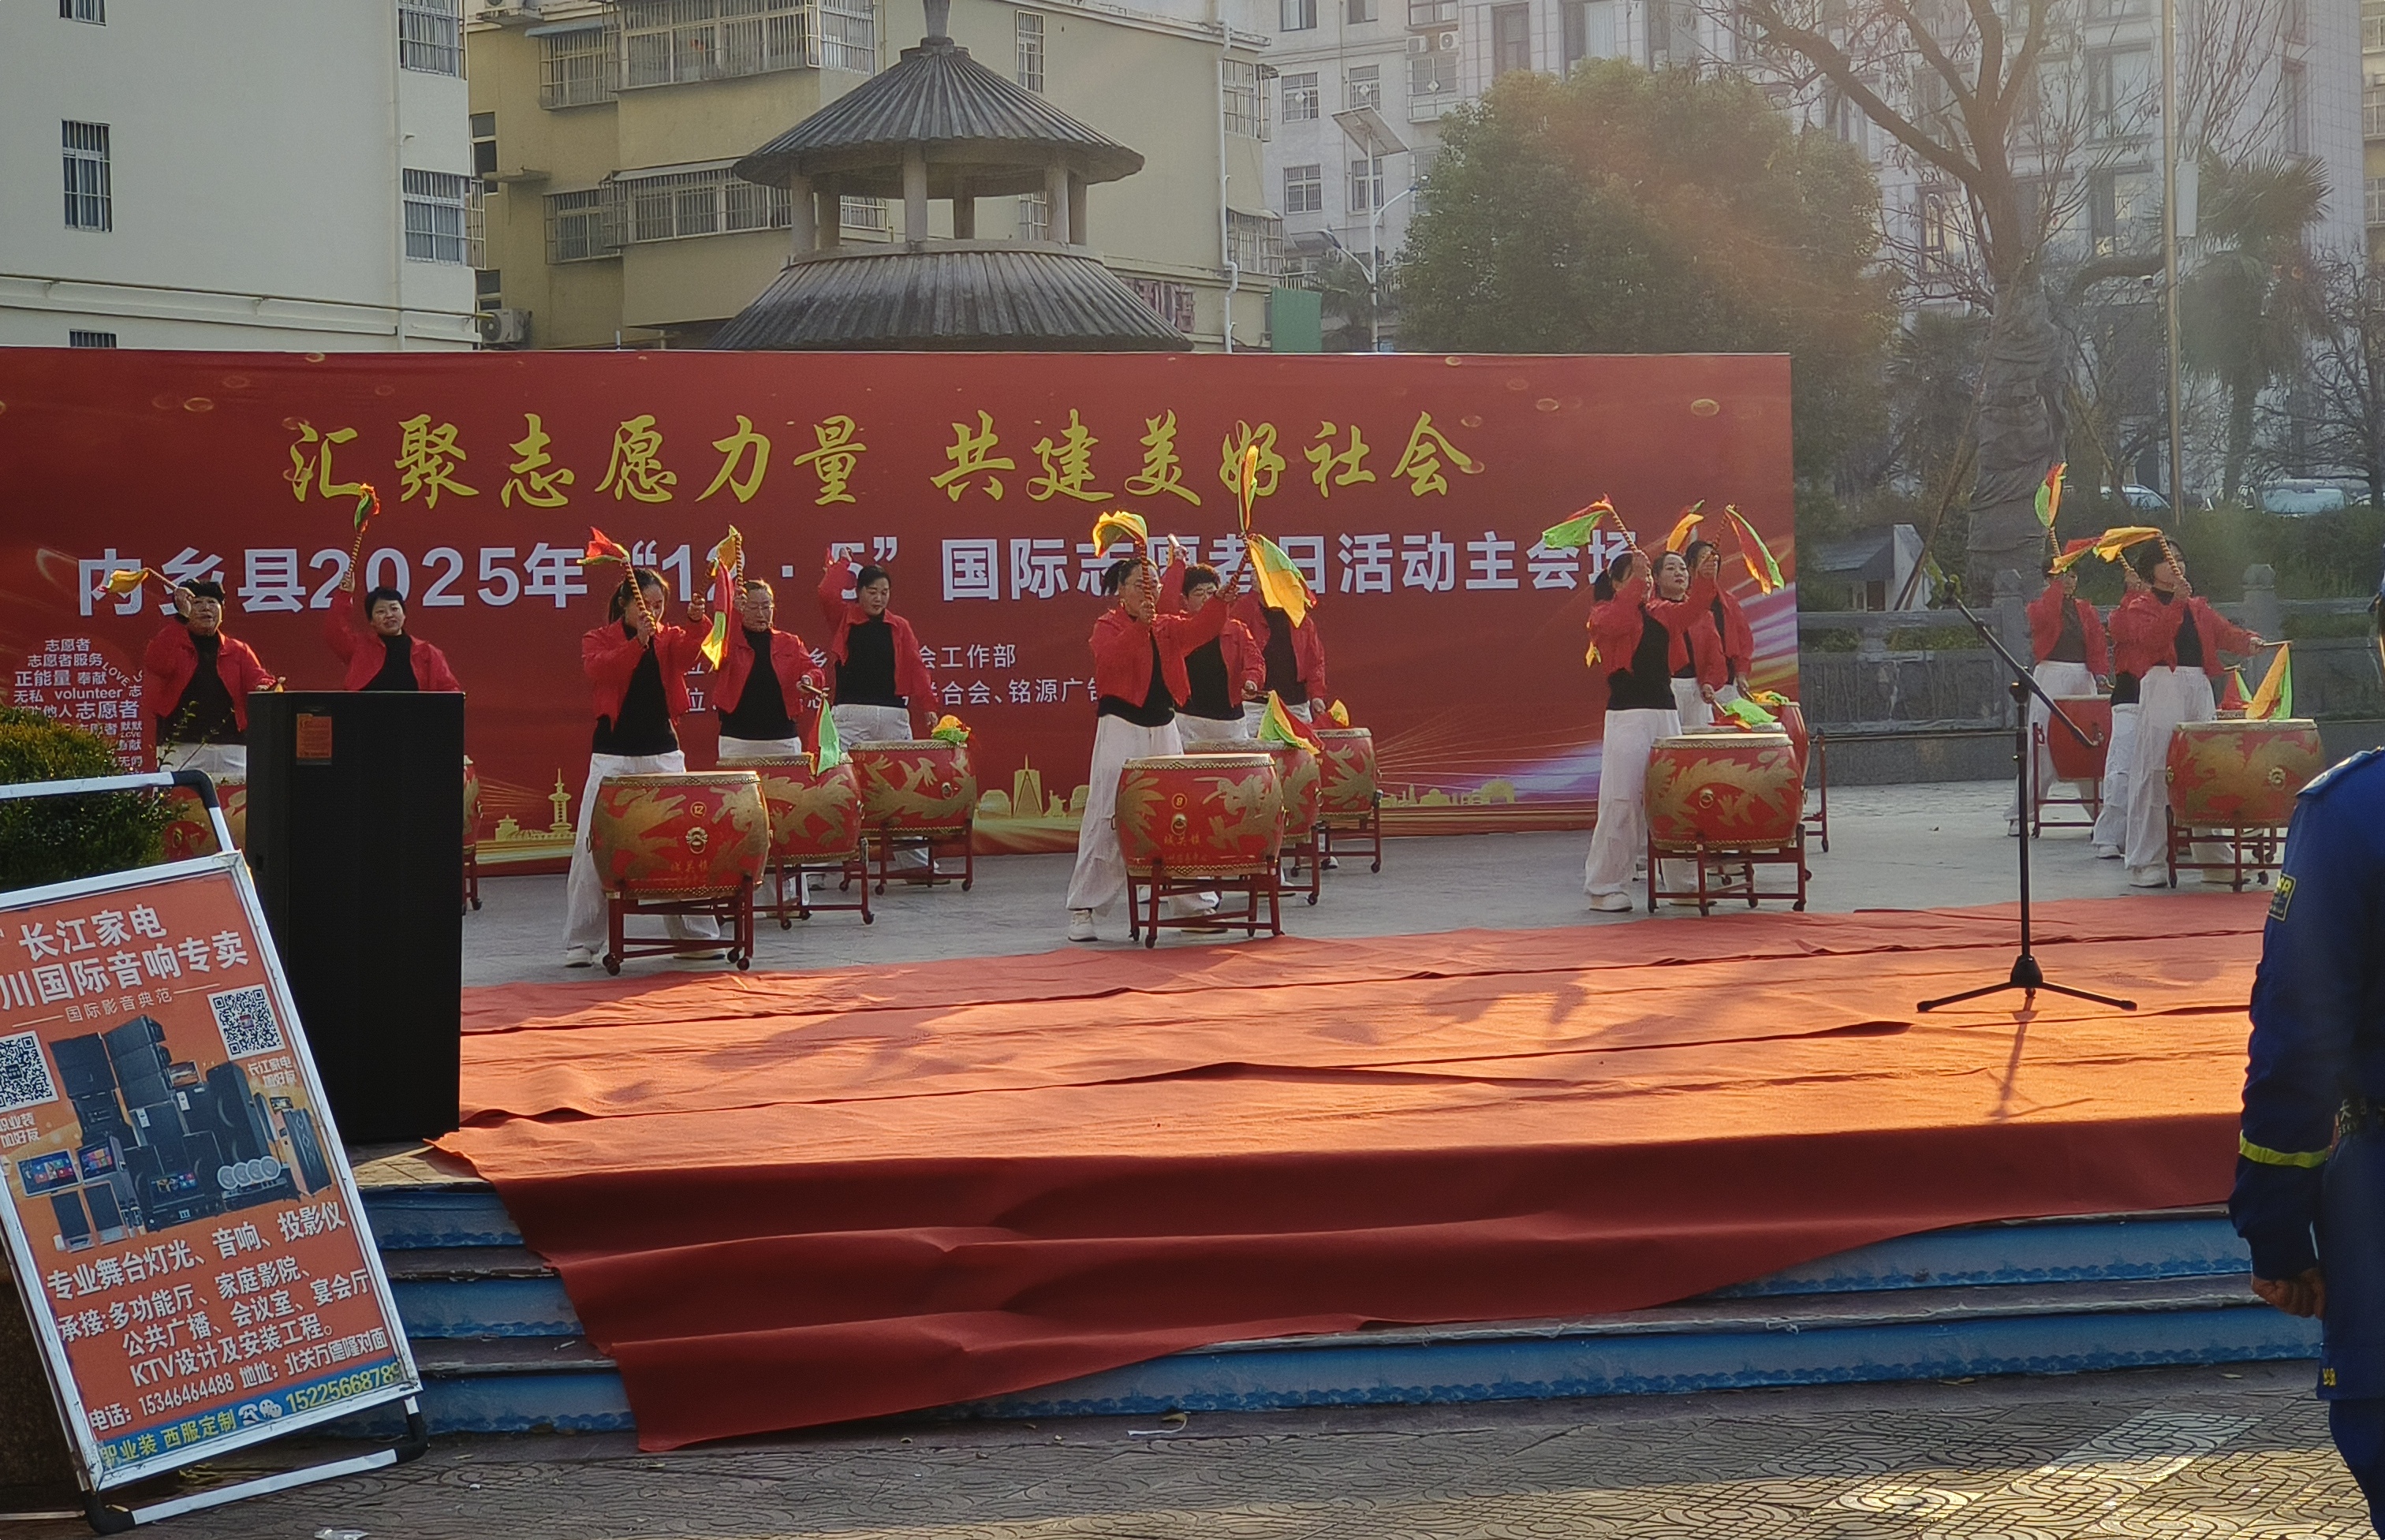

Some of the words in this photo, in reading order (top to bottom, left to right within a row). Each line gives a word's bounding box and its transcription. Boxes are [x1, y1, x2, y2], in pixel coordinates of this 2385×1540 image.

[289, 413, 867, 509] 汇聚志愿力量
[930, 409, 1472, 505] 共建美好社会
[45, 638, 91, 652] 志愿者
[28, 653, 103, 667] 志愿者服务
[15, 669, 71, 687] 正能量
[77, 672, 106, 685] 奉献
[102, 662, 131, 687] LOVE
[13, 690, 43, 703] 无私
[54, 688, 123, 699] volunteer
[75, 700, 139, 719] 志愿者
[693, 805, 704, 815] 12
[1176, 796, 1183, 806] 8
[18, 904, 167, 961] 长江家电
[65, 987, 172, 1023] 国际影音典范
[160, 1408, 237, 1449] 西服定制
[286, 1363, 401, 1413] 15225668789
